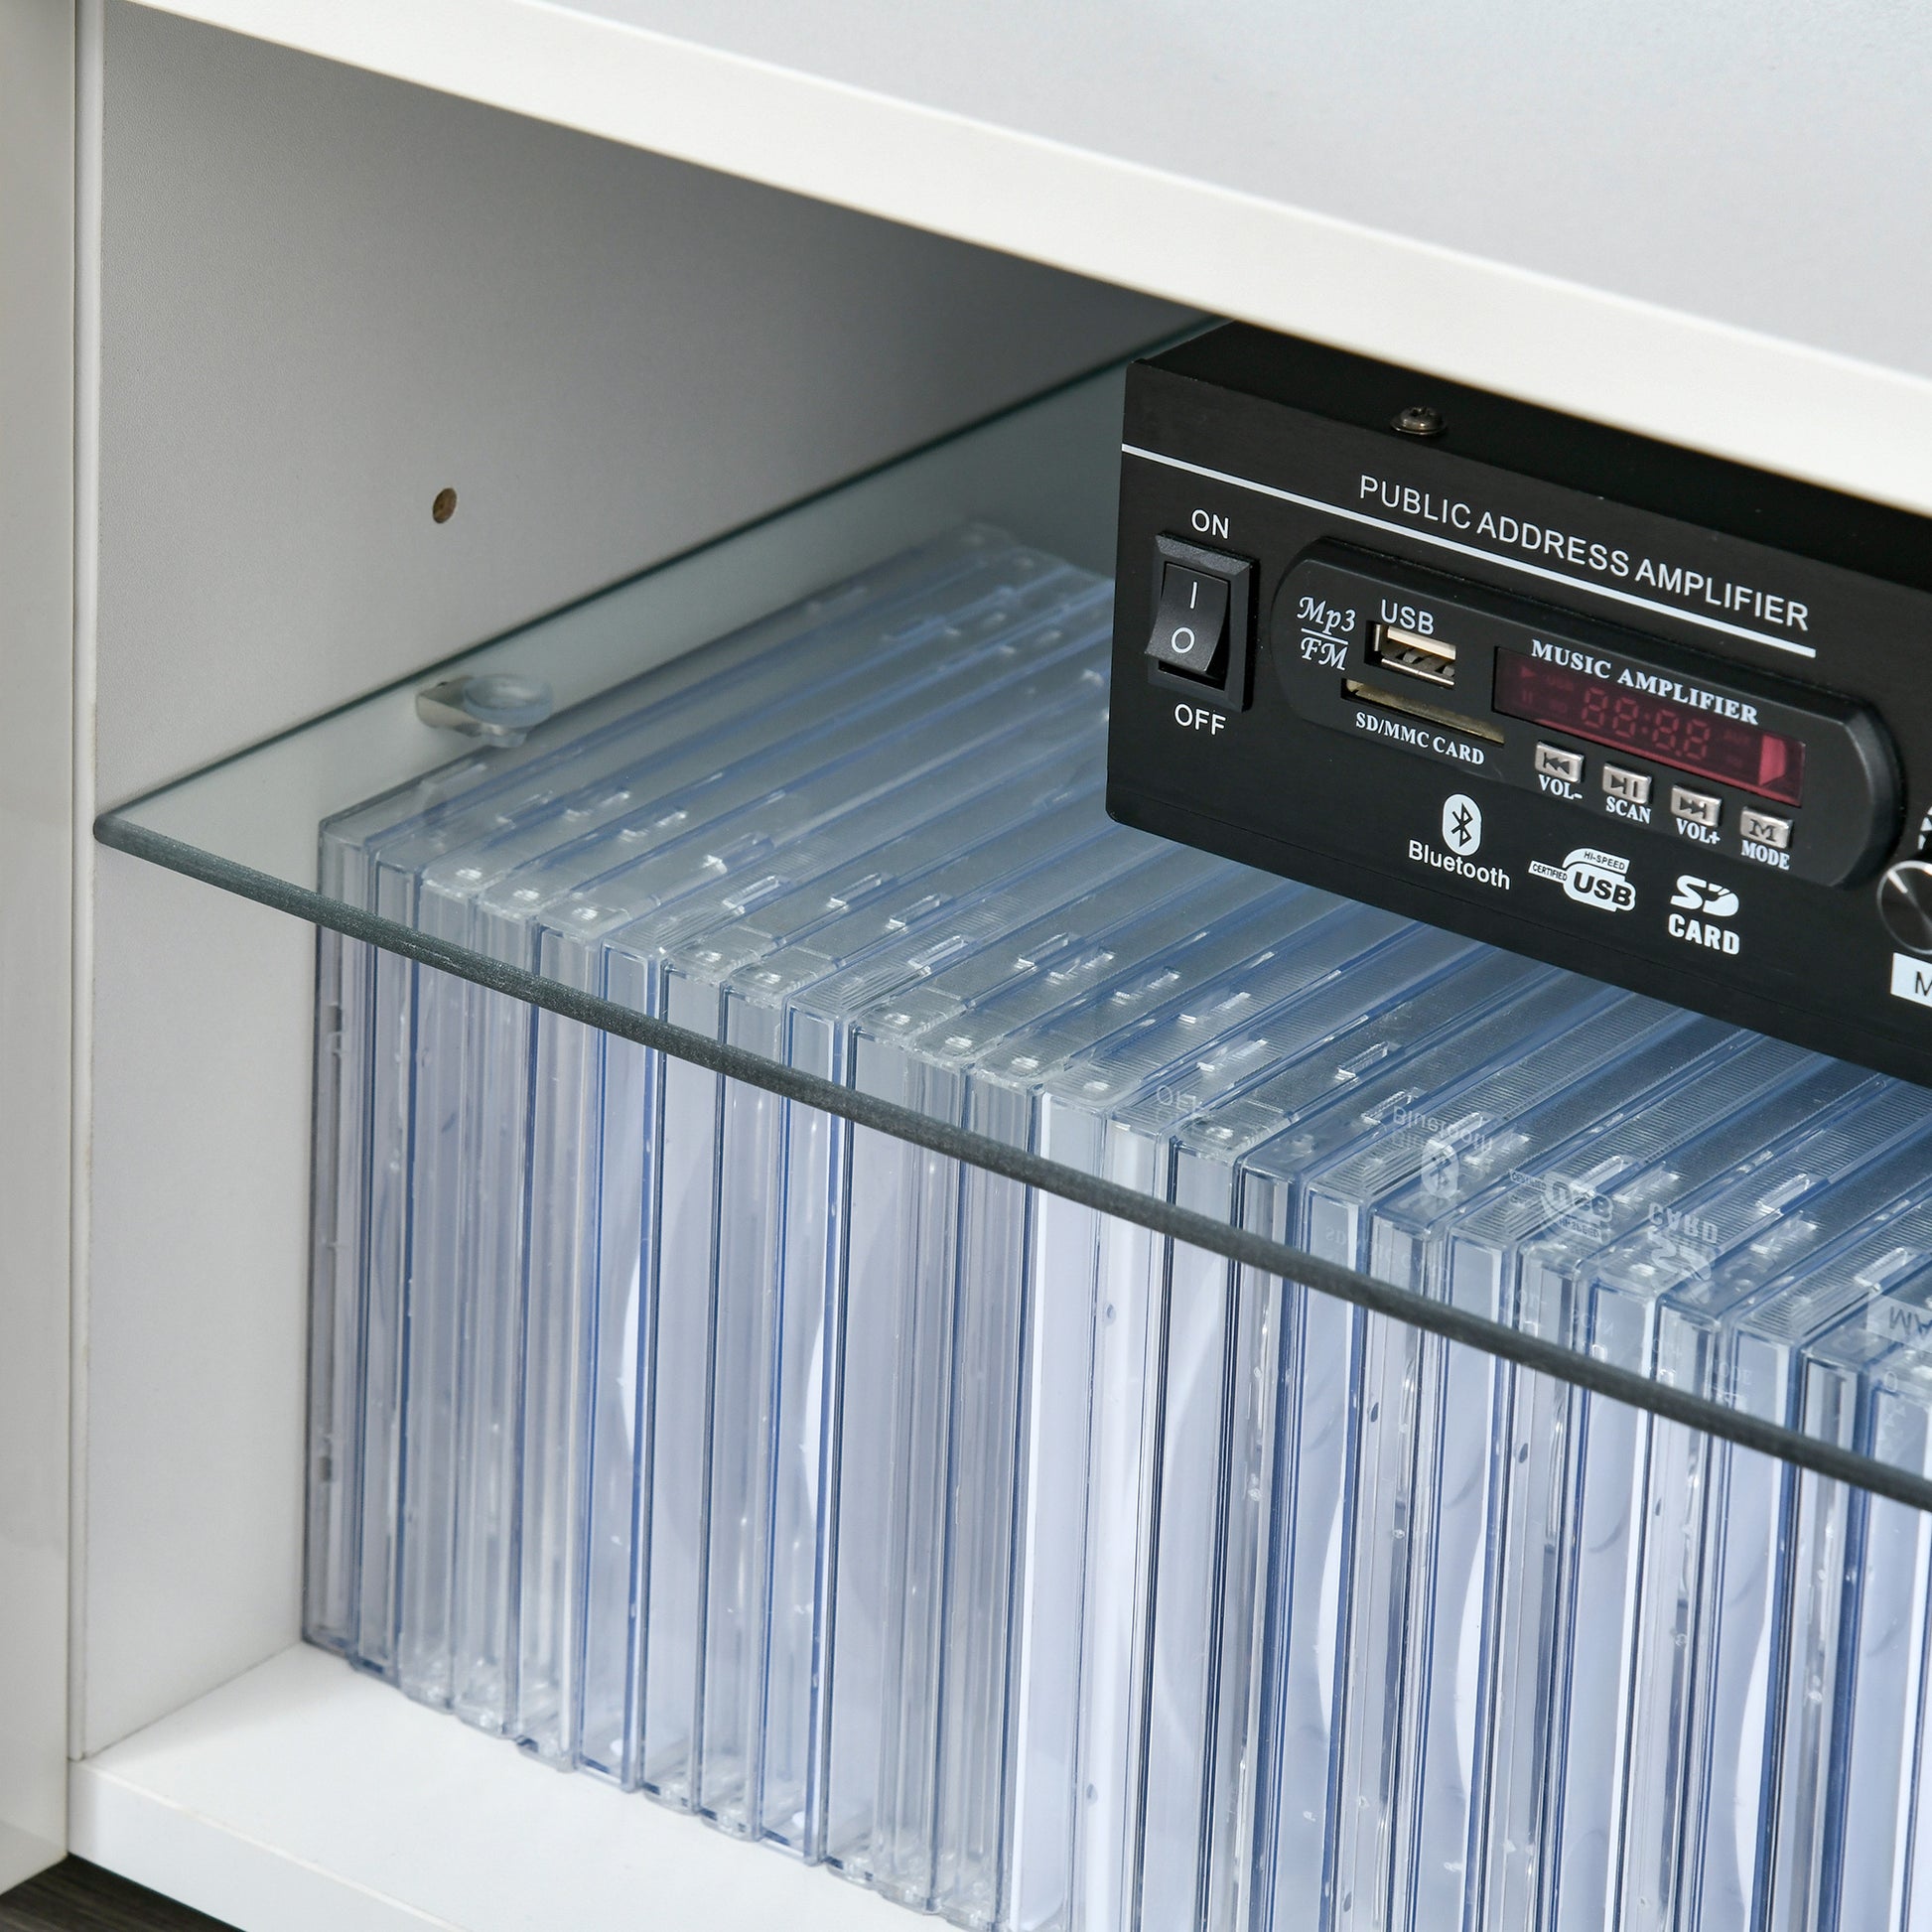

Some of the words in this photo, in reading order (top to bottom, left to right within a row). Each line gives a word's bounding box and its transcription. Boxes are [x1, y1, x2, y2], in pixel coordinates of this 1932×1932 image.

[1191, 508, 1230, 539] ON
[1359, 475, 1472, 530] PUBLIC
[1476, 512, 1631, 579] ADDRESS
[1634, 558, 1810, 632] AMPLIFIER
[1297, 596, 1357, 634] Mp3
[1381, 599, 1435, 635] USB
[1301, 636, 1349, 671] FM
[1531, 638, 1612, 679] MUSIC
[1616, 668, 1759, 726] AMPLIFIER
[1174, 703, 1226, 736] OFF
[1355, 710, 1431, 749] SD/MMC
[1433, 735, 1485, 765] CARD
[1538, 774, 1583, 800] VOL-
[1605, 796, 1652, 824] SCAN
[1676, 817, 1721, 845] VOL+
[1749, 818, 1777, 842] M
[1408, 839, 1511, 891] Bluetooth
[1532, 863, 1568, 882] CERTIFIED
[1584, 850, 1626, 872] HI-SPEED
[1740, 839, 1791, 871] MODE
[1573, 871, 1633, 906] USB
[1670, 875, 1739, 917] SD
[1668, 912, 1740, 955] CARD
